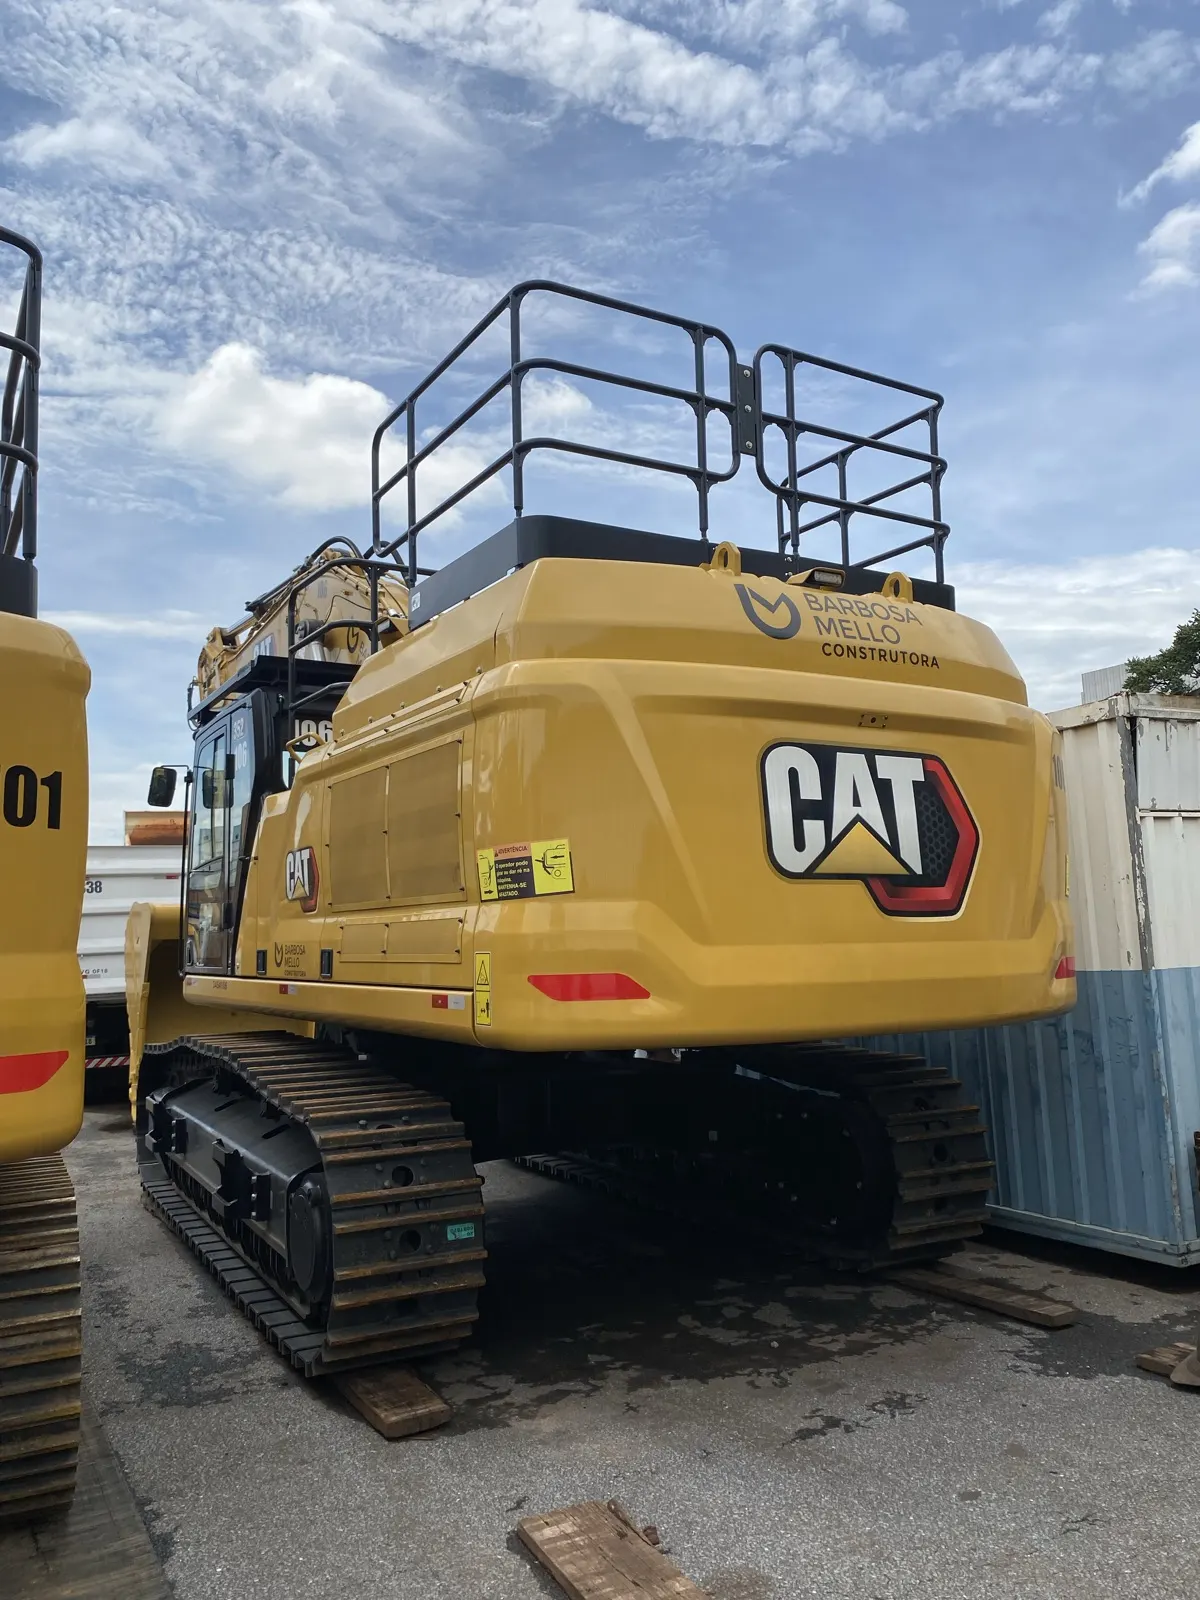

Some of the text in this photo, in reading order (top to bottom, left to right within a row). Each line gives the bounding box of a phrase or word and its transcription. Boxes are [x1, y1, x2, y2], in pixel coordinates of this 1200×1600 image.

[803, 592, 924, 626] BARBOSA
[813, 615, 901, 645] MELLO
[821, 642, 940, 669] CONSTRUTORA
[295, 719, 334, 746] 106
[0, 764, 62, 830] 01
[764, 745, 925, 875] CAT
[84, 880, 103, 894] 38
[286, 848, 310, 900] CAT
[284, 944, 306, 955] BARBOSA
[284, 957, 300, 968] MELLO
